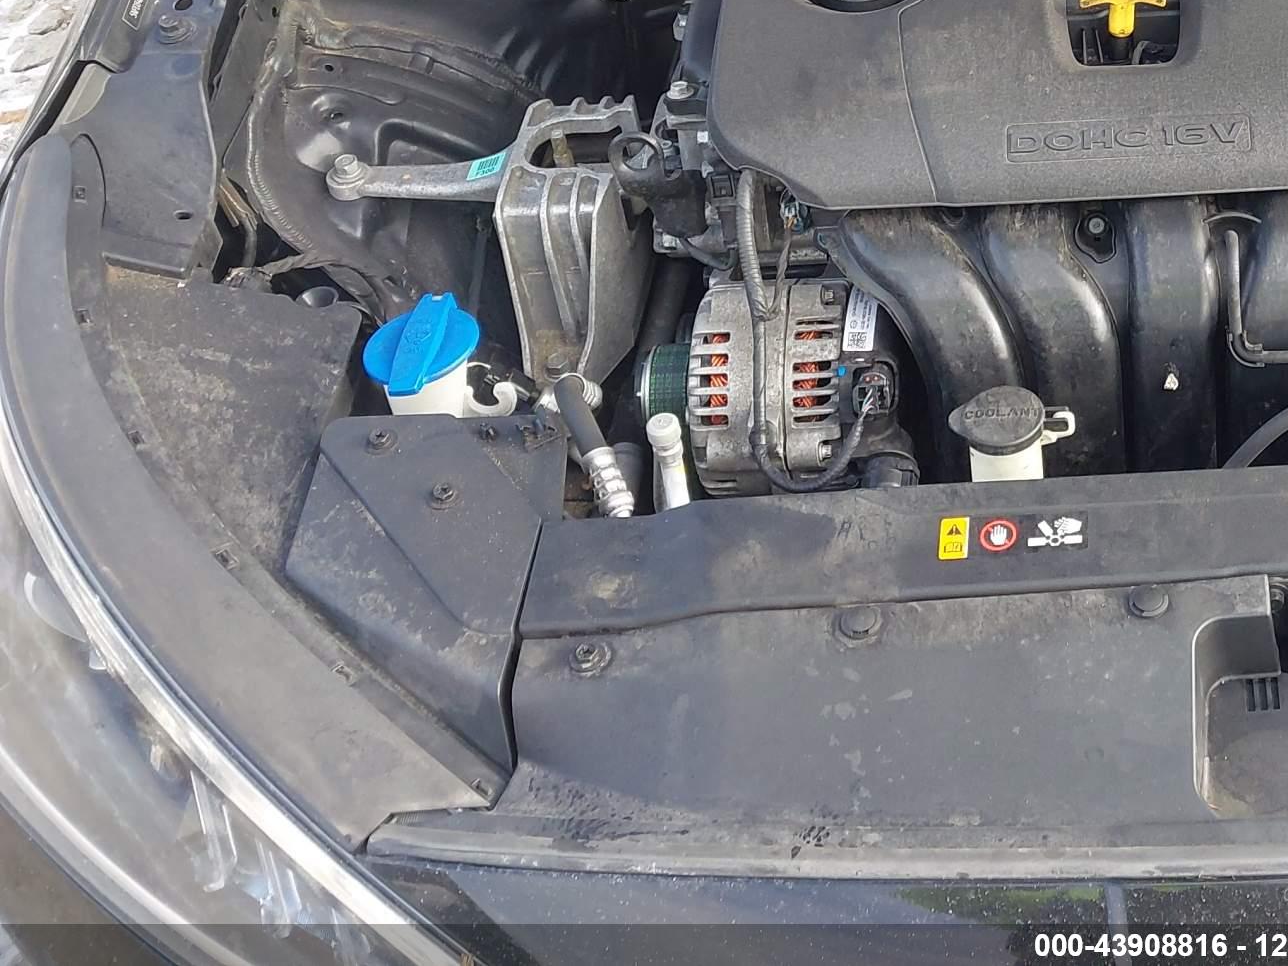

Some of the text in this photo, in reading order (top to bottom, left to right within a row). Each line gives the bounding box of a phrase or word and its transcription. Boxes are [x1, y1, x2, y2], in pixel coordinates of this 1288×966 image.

[1007, 121, 1246, 154] DOHC 16V
[963, 407, 1040, 421] COOLANT
